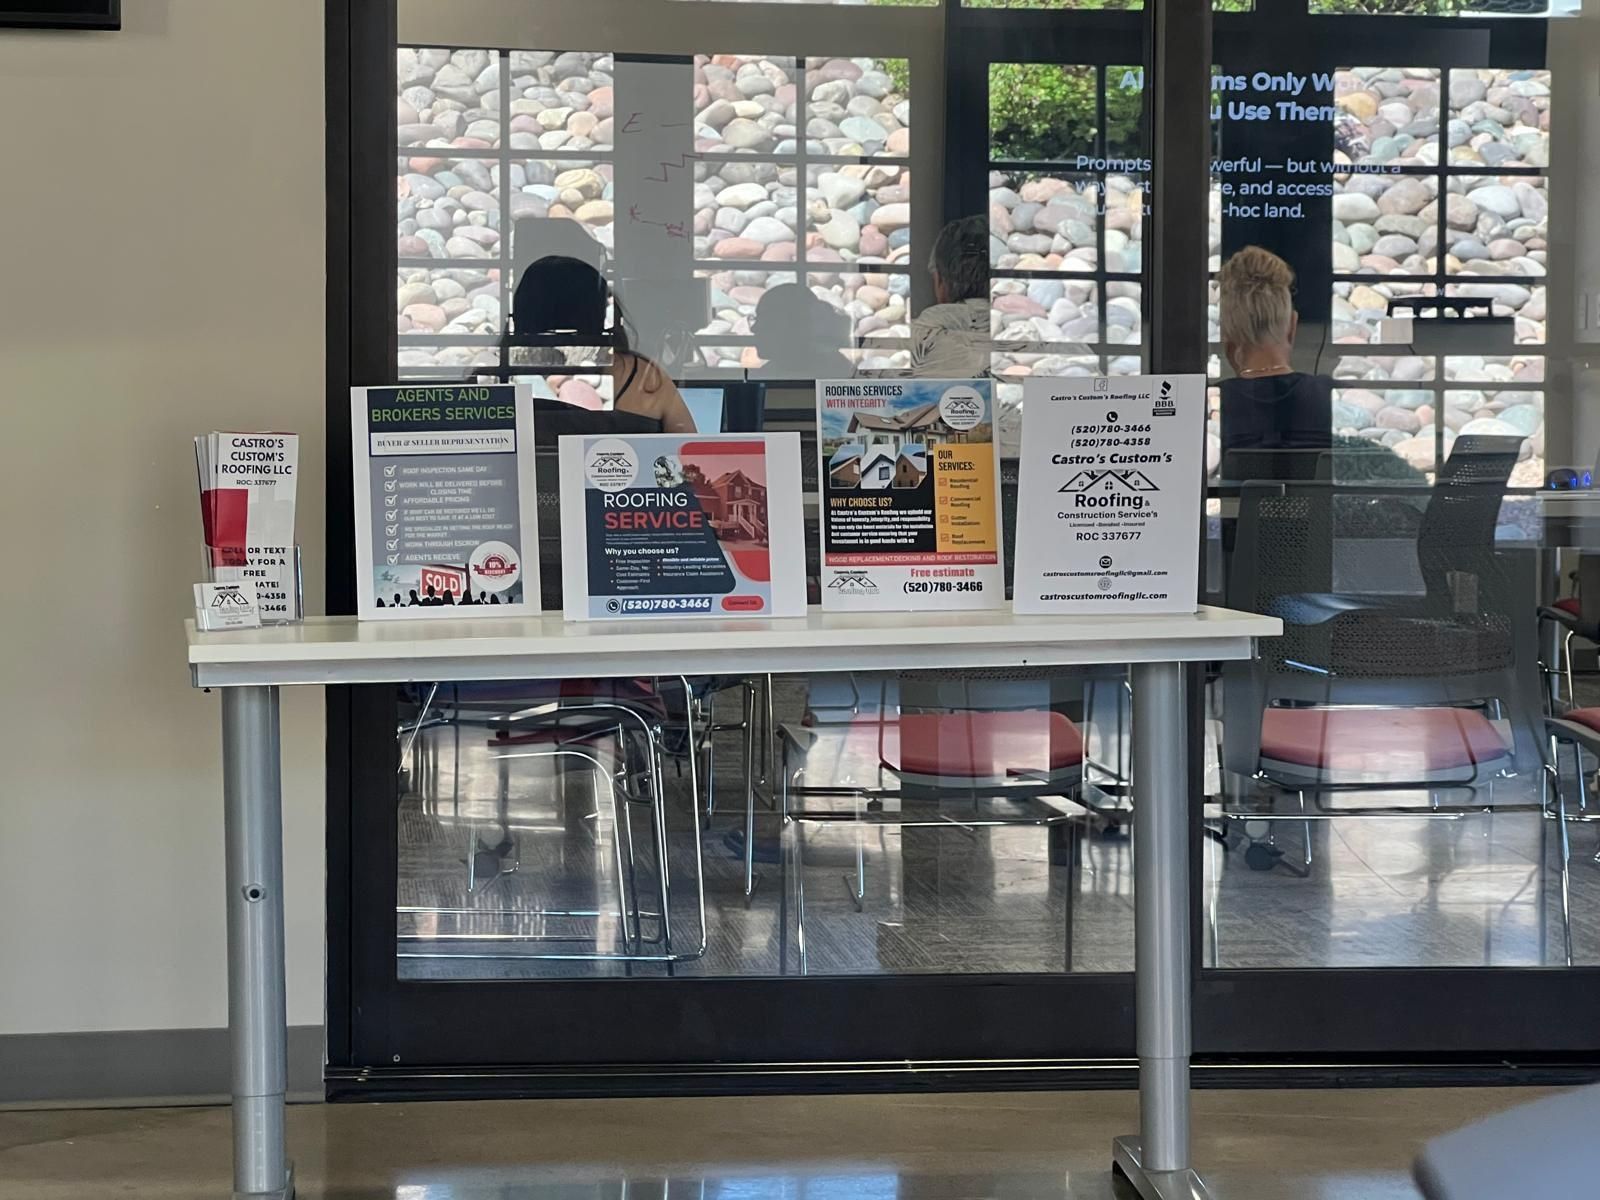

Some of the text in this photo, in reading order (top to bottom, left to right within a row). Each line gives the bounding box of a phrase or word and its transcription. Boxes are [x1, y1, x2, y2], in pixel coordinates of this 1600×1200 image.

[1252, 72, 1306, 95] Only
[1228, 101, 1271, 121] Use
[1076, 155, 1152, 174] Prompts
[1210, 157, 1261, 173] werful
[1287, 158, 1316, 173] but
[1240, 180, 1272, 195] and
[1276, 183, 1333, 195] access
[1223, 203, 1305, 218] -hoc land.
[396, 388, 489, 402] AGENTS AND
[825, 385, 902, 396] ROOFING SERVICES
[826, 399, 887, 408] WITH INTEGRITY
[372, 406, 515, 422] BROKERS SERVICES
[1071, 425, 1151, 435] (520)780-3466
[232, 438, 284, 448] CASTRO'S
[441, 438, 509, 446] REPRESENTATION
[1071, 438, 1151, 448] (520)780-4358
[231, 452, 284, 461] CUSTOM'S
[938, 450, 952, 459] OUR
[1052, 452, 1172, 465] Castro's Custom's
[222, 465, 292, 474] ROOFING LLC
[939, 462, 975, 471] SERVICES:
[604, 493, 688, 507] ROOFING
[830, 497, 893, 507] WHY CHOOSE US?
[1075, 493, 1143, 509] Roofing
[1118, 510, 1158, 518] Service's
[604, 511, 703, 529] SERVICE
[1076, 532, 1141, 541] ROC 337677
[605, 548, 621, 556] Why
[911, 568, 975, 577] Free estimate
[425, 573, 458, 592] SOLD
[903, 581, 982, 594] (520)780-3466
[1040, 592, 1168, 601] castroscustomroofingllc.com
[622, 599, 710, 612] (520)780-3466
